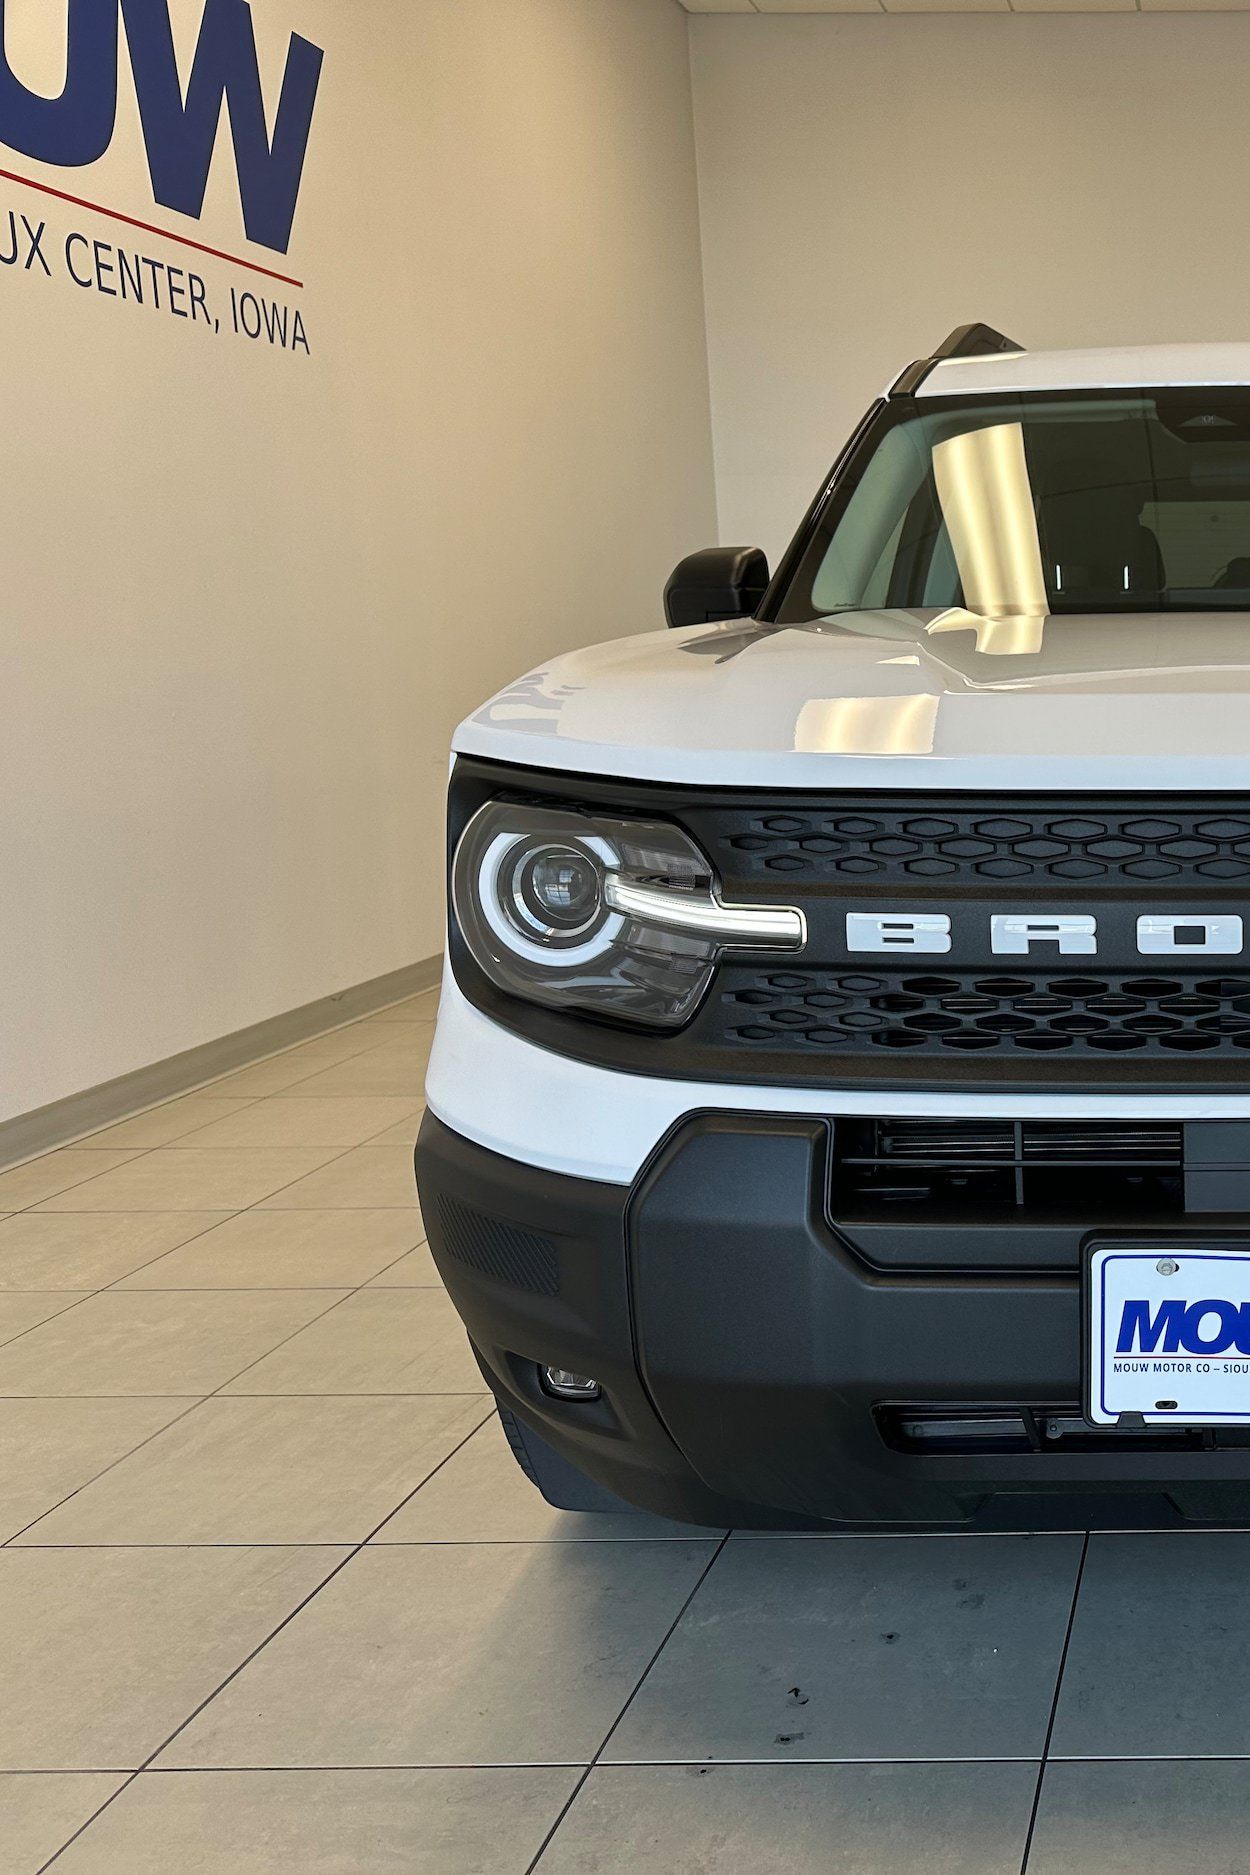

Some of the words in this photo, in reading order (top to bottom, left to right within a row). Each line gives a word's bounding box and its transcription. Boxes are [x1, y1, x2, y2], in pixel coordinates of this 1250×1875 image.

[65, 232, 220, 335] CENTER,
[230, 287, 311, 356] IOWA
[1113, 1363, 1149, 1373] MOUW
[1153, 1363, 1192, 1373] MOTOR
[1196, 1363, 1210, 1373] CO
